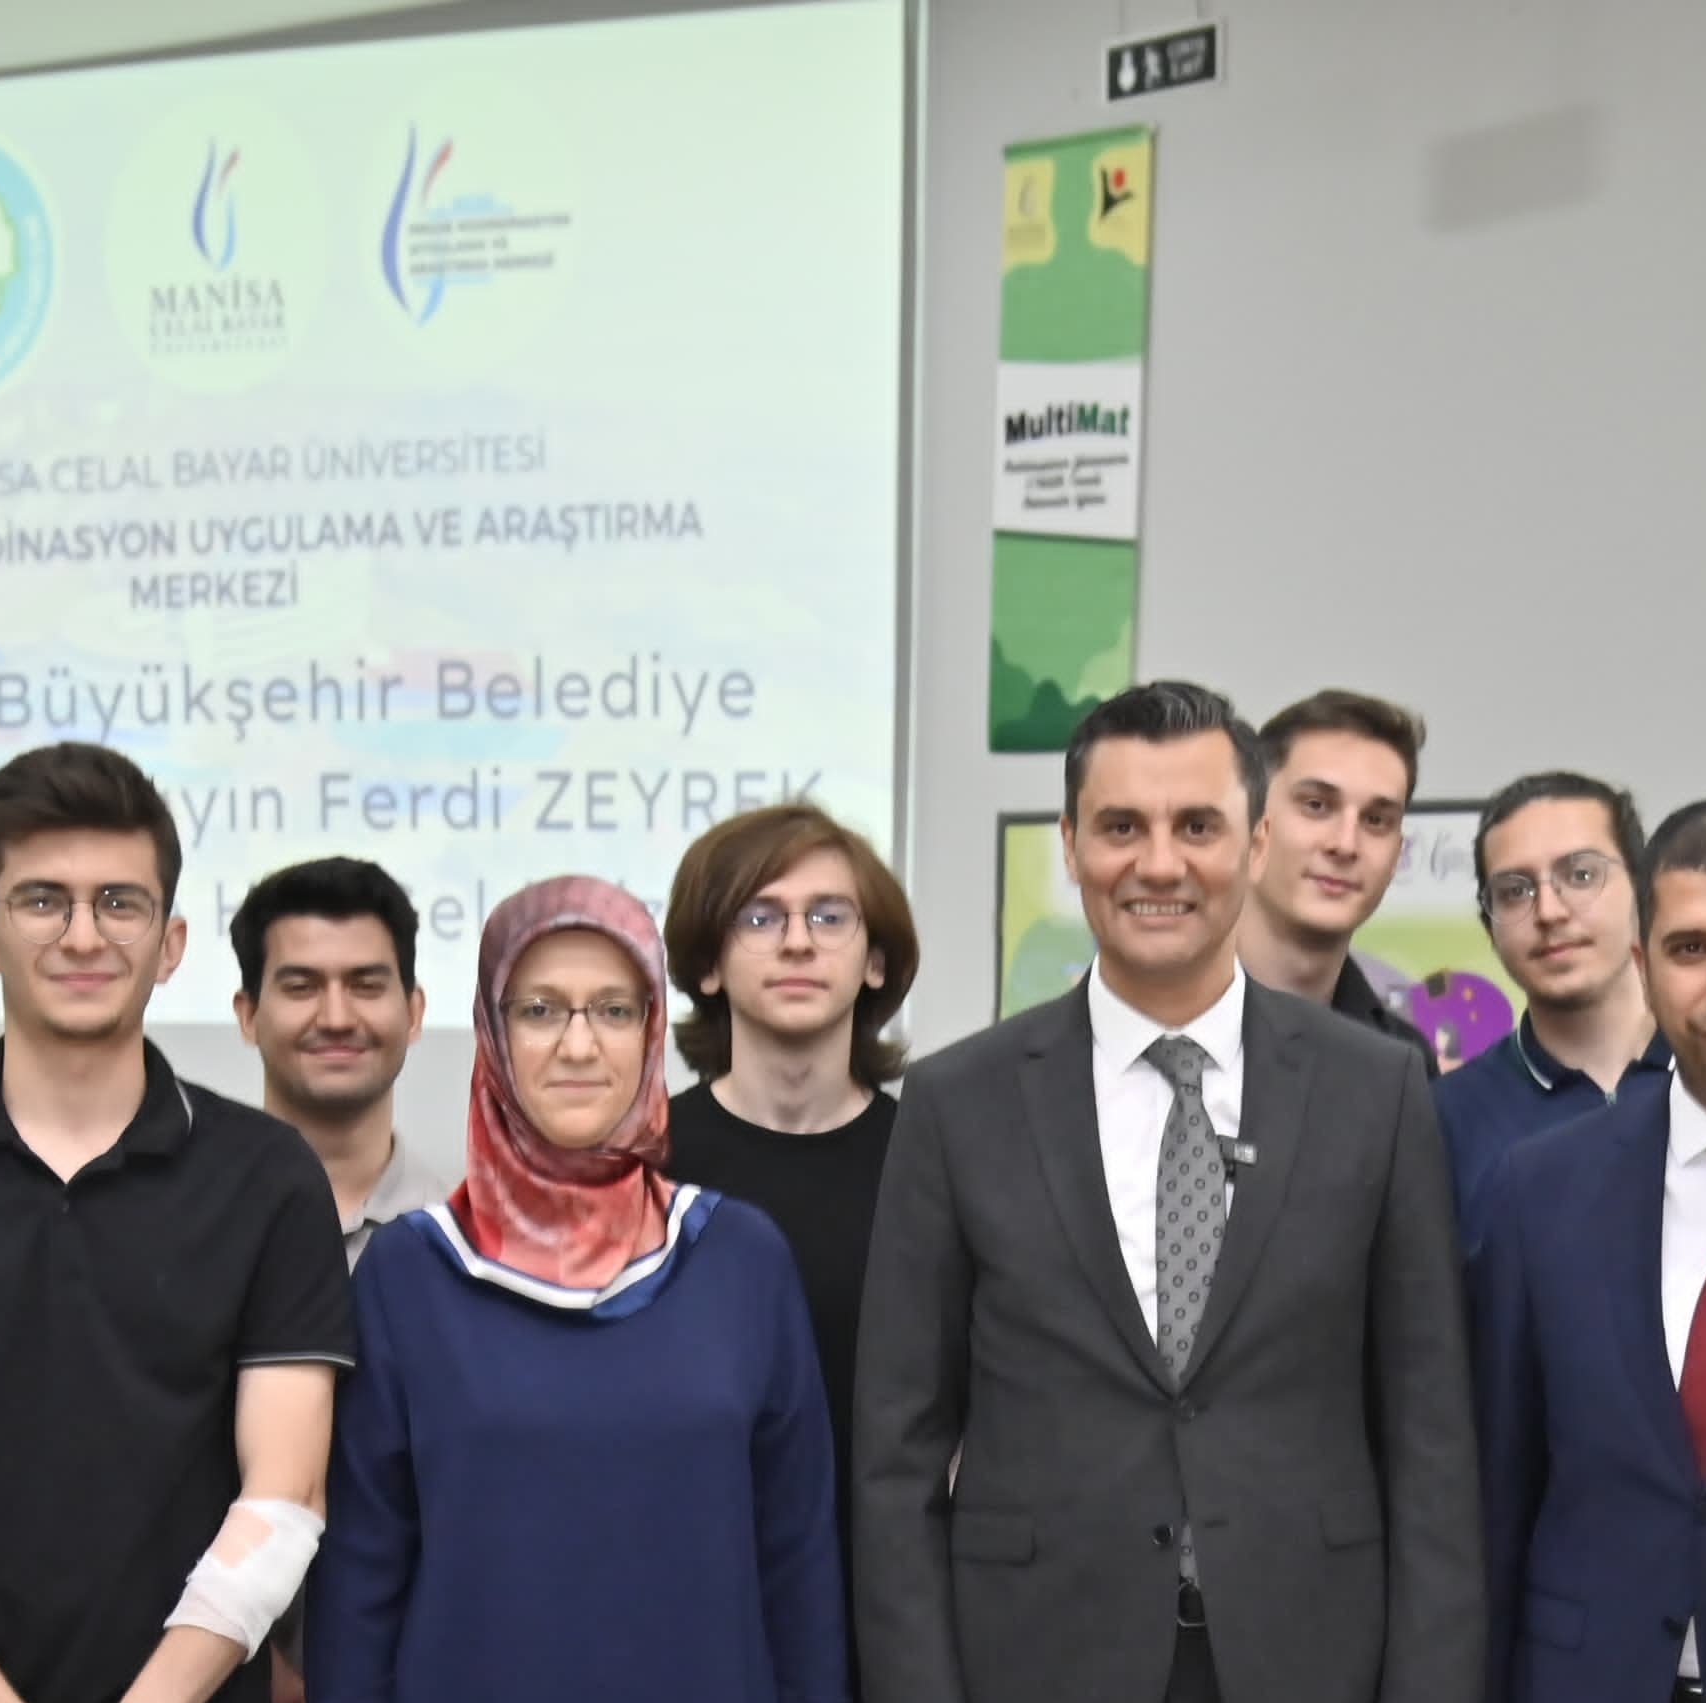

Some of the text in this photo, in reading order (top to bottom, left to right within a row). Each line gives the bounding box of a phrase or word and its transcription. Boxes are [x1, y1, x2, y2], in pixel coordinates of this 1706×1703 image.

[1005, 401, 1130, 444] MultiMat
[50, 456, 160, 495] CELAL
[174, 448, 291, 488] BAYAR
[302, 428, 548, 481] ÜNİVERSİTESİ
[189, 509, 403, 557] UYGULAMA
[414, 508, 463, 548] VE
[475, 502, 705, 552] ARAŞTIRMA
[129, 560, 299, 610] MERKEZİ
[436, 651, 757, 737] Belediye
[319, 766, 502, 832] Ferdi
